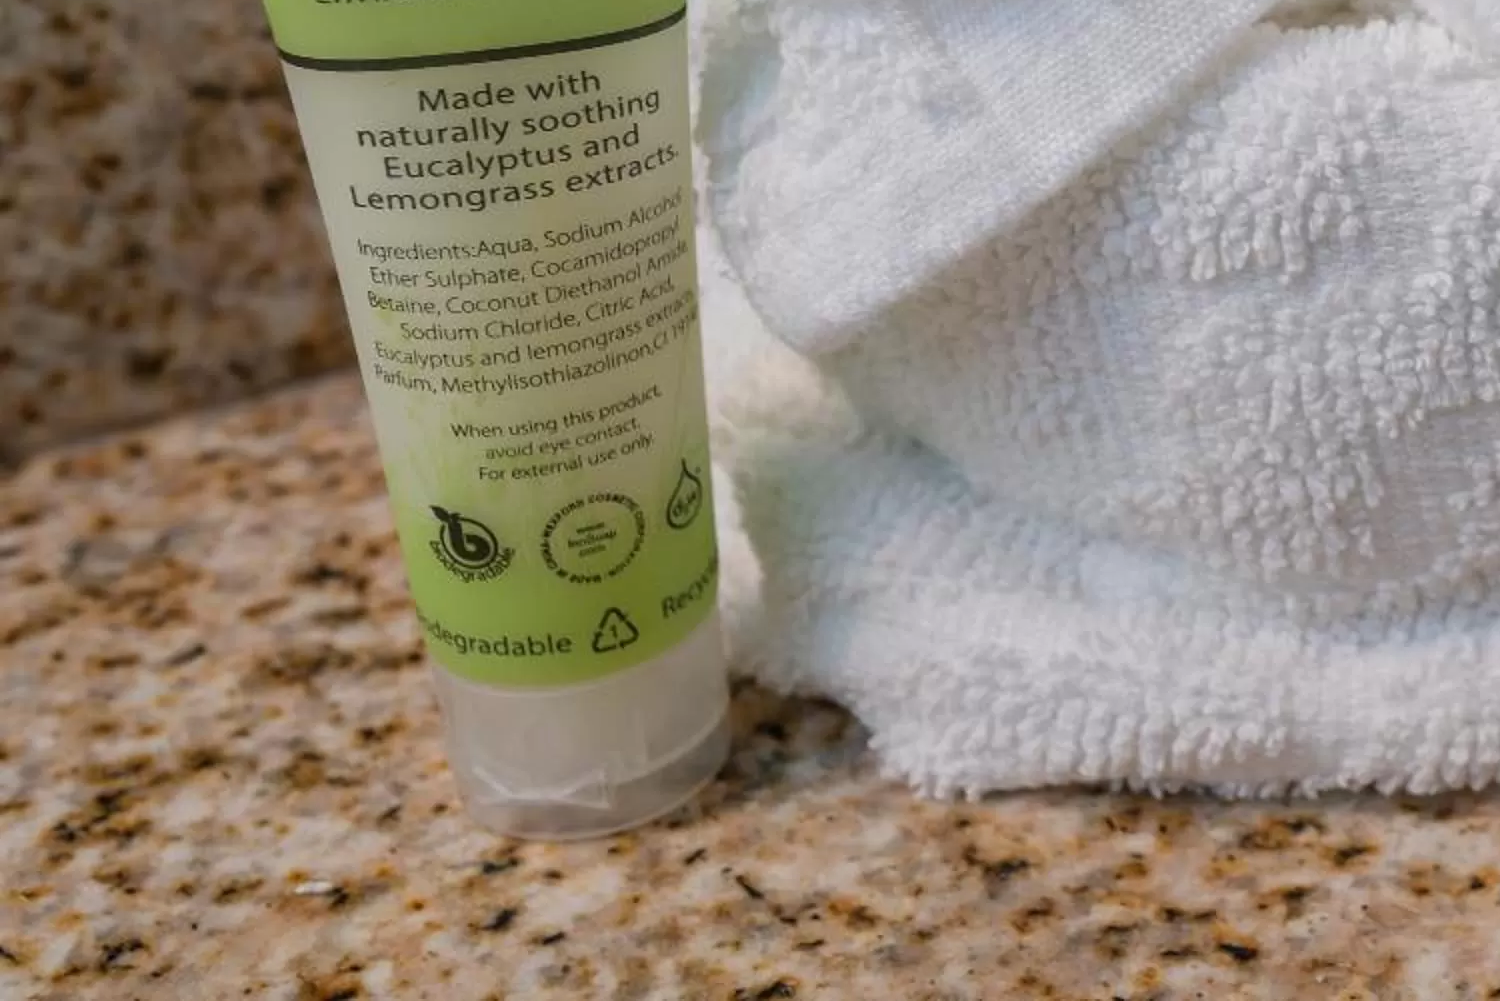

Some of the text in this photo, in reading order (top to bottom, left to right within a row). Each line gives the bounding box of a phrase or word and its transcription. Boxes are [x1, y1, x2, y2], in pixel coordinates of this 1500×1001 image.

[418, 70, 601, 112] Made with
[357, 90, 660, 148] naturally soothing
[383, 123, 640, 180] Eucalyptus and
[349, 144, 679, 212] Lemongrass extracts.
[543, 220, 623, 248] Sodium
[369, 266, 419, 288] Ether
[425, 267, 525, 290] Sulphate,
[445, 291, 540, 314] Coconut
[545, 262, 641, 304] Diethanol
[400, 322, 479, 341] Sodium
[485, 312, 580, 339] Chloride,
[585, 297, 634, 322] Citric
[374, 340, 475, 370] Eucalyptus
[480, 346, 520, 366] and
[527, 321, 642, 360] lemongrass
[450, 422, 503, 440] When
[508, 418, 557, 437] using
[563, 410, 594, 429] this
[478, 466, 505, 481] For
[511, 455, 583, 480] external
[587, 448, 617, 467] use
[485, 440, 533, 461] avoid
[539, 439, 571, 457] eye
